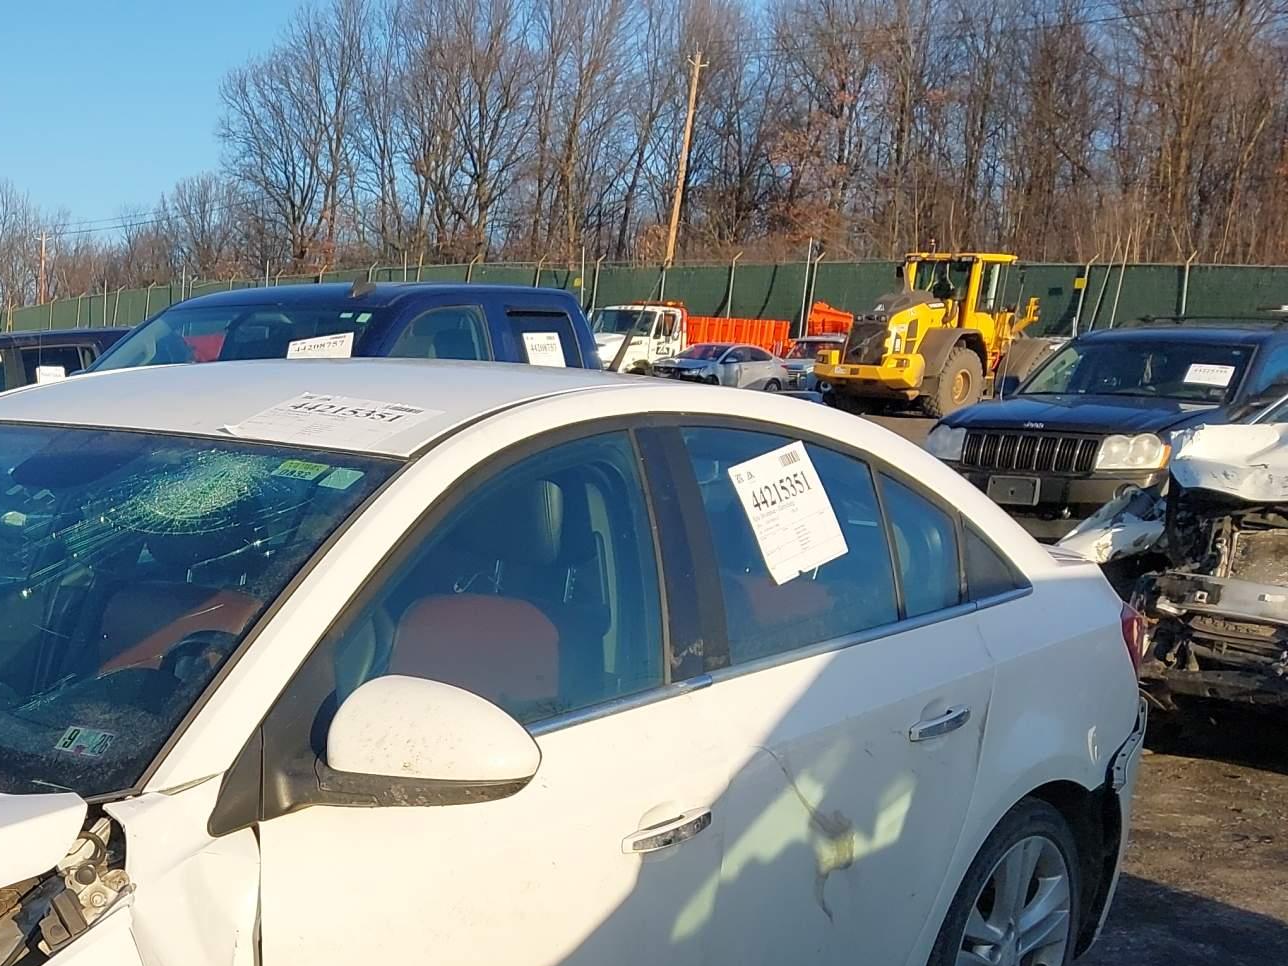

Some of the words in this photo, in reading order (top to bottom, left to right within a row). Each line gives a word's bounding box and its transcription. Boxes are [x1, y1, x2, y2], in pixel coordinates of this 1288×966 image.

[289, 402, 403, 423] 44215351
[752, 470, 812, 512] 44215351
[62, 729, 80, 748] 9
[91, 734, 113, 754] 26
